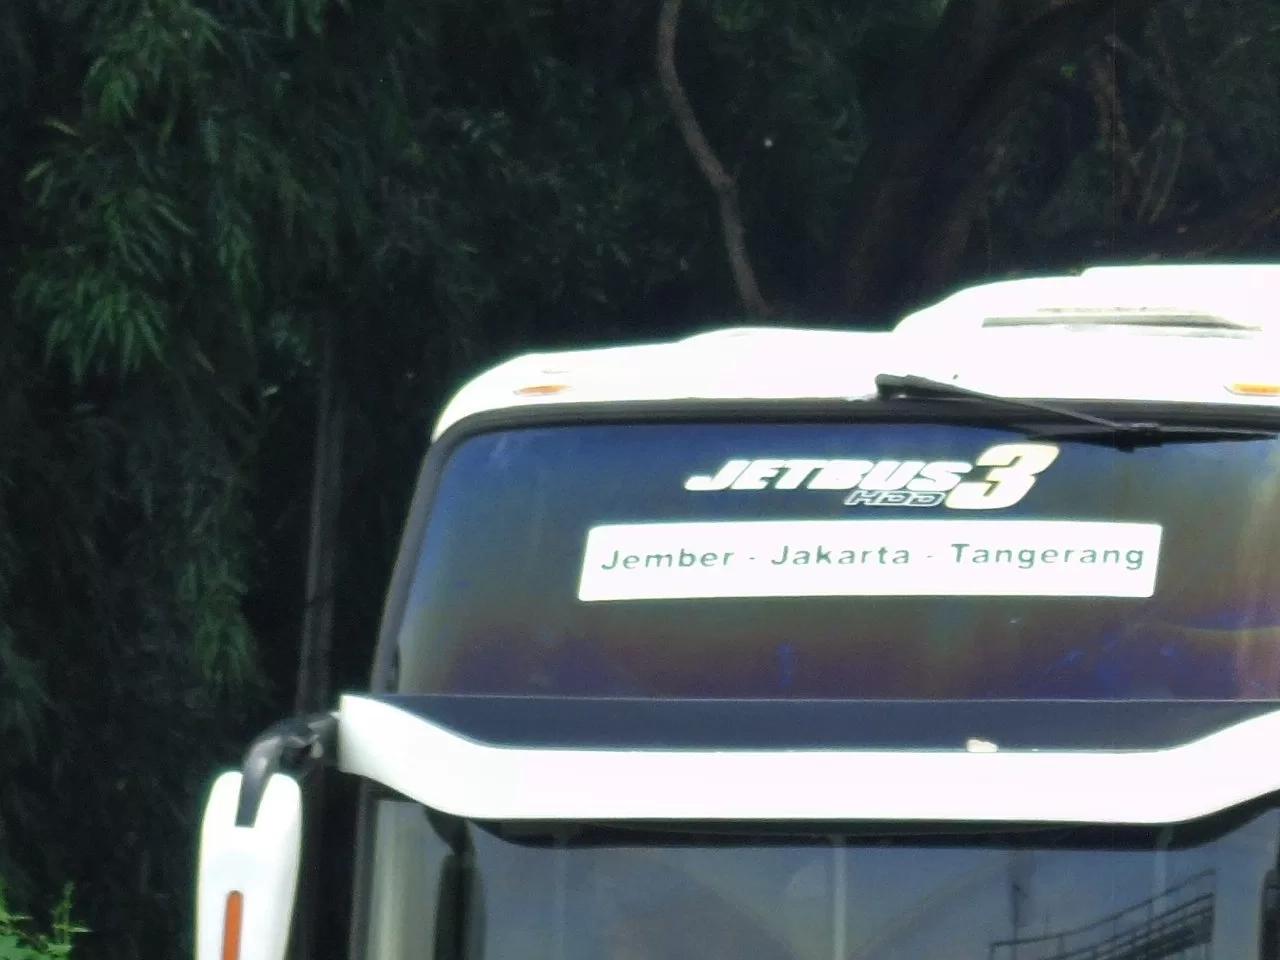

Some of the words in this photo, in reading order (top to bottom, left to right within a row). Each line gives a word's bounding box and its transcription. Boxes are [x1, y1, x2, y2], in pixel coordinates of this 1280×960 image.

[684, 459, 973, 492] JETBUS
[601, 547, 735, 571] Jember
[771, 545, 910, 566] Jakarta
[950, 543, 1145, 571] Tangerang
